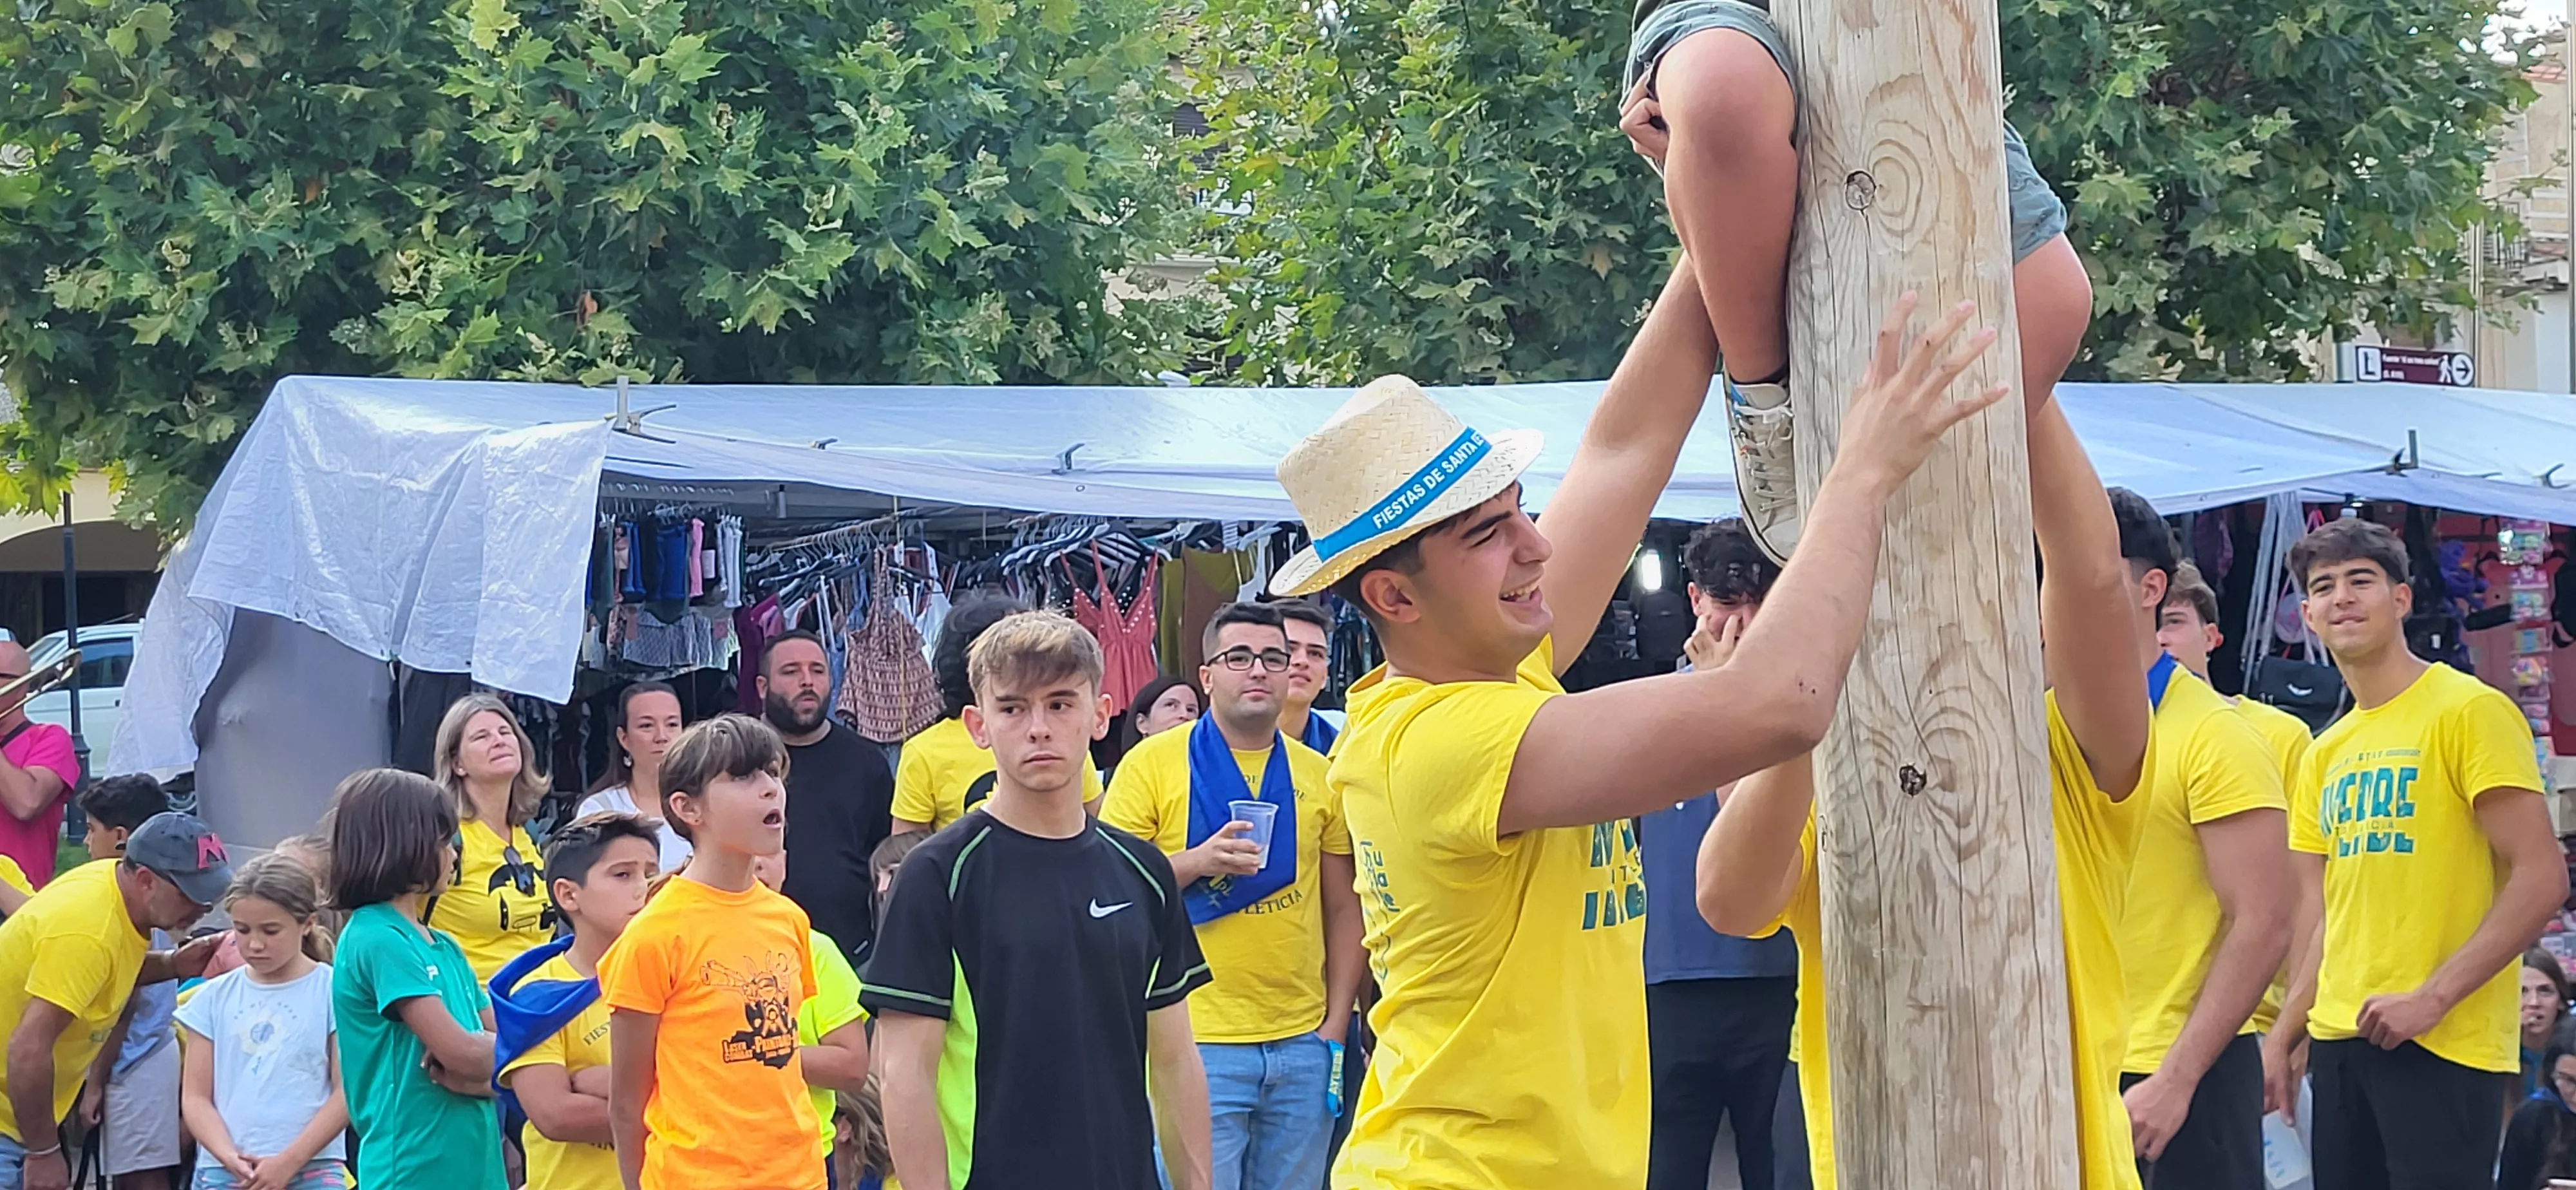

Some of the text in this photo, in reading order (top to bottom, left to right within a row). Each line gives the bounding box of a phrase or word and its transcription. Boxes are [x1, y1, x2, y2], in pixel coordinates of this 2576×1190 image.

[2363, 352, 2376, 375] L
[1372, 441, 1478, 529] FIESTAS DE SANTA
[197, 833, 230, 869] M
[1244, 888, 1303, 915] LETICIA
